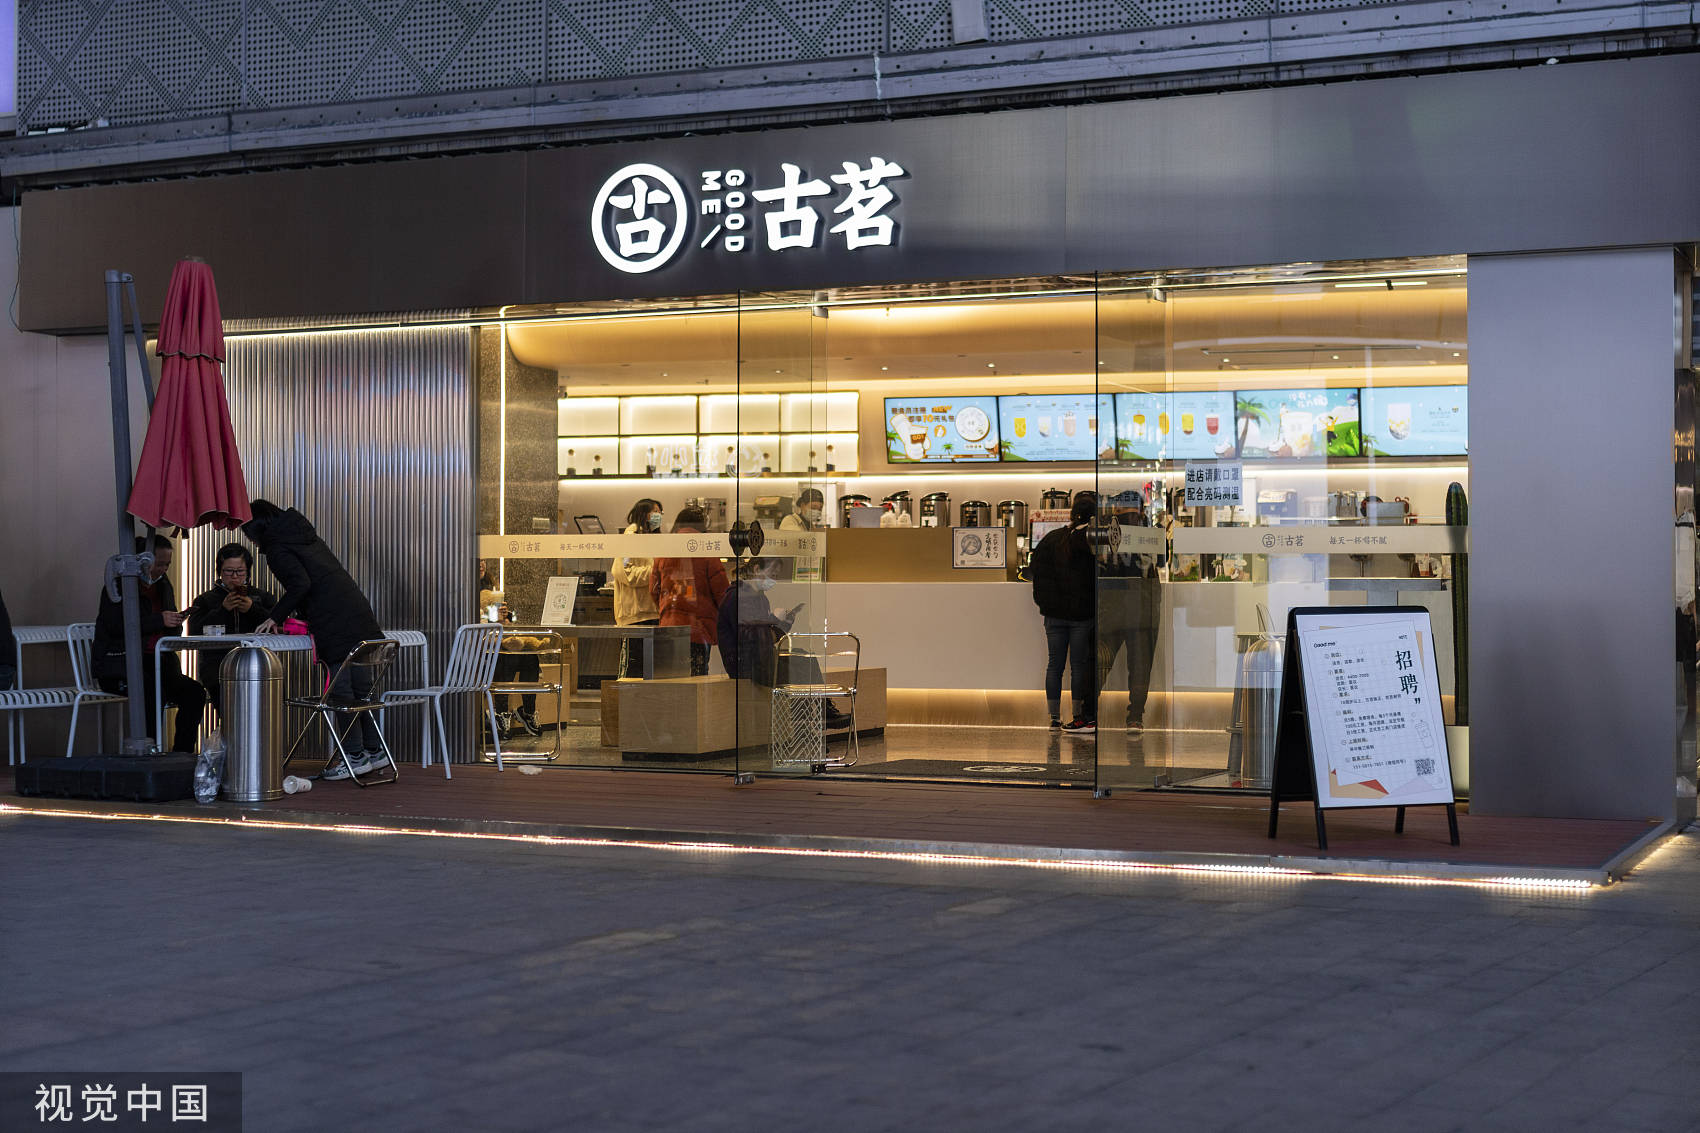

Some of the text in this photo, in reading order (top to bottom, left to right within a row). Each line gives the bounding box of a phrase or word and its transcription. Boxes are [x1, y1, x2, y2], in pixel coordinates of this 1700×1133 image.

[725, 169, 746, 252] GOOD
[752, 157, 904, 251] 古茗
[1187, 486, 1240, 501] 配合亮码测温
